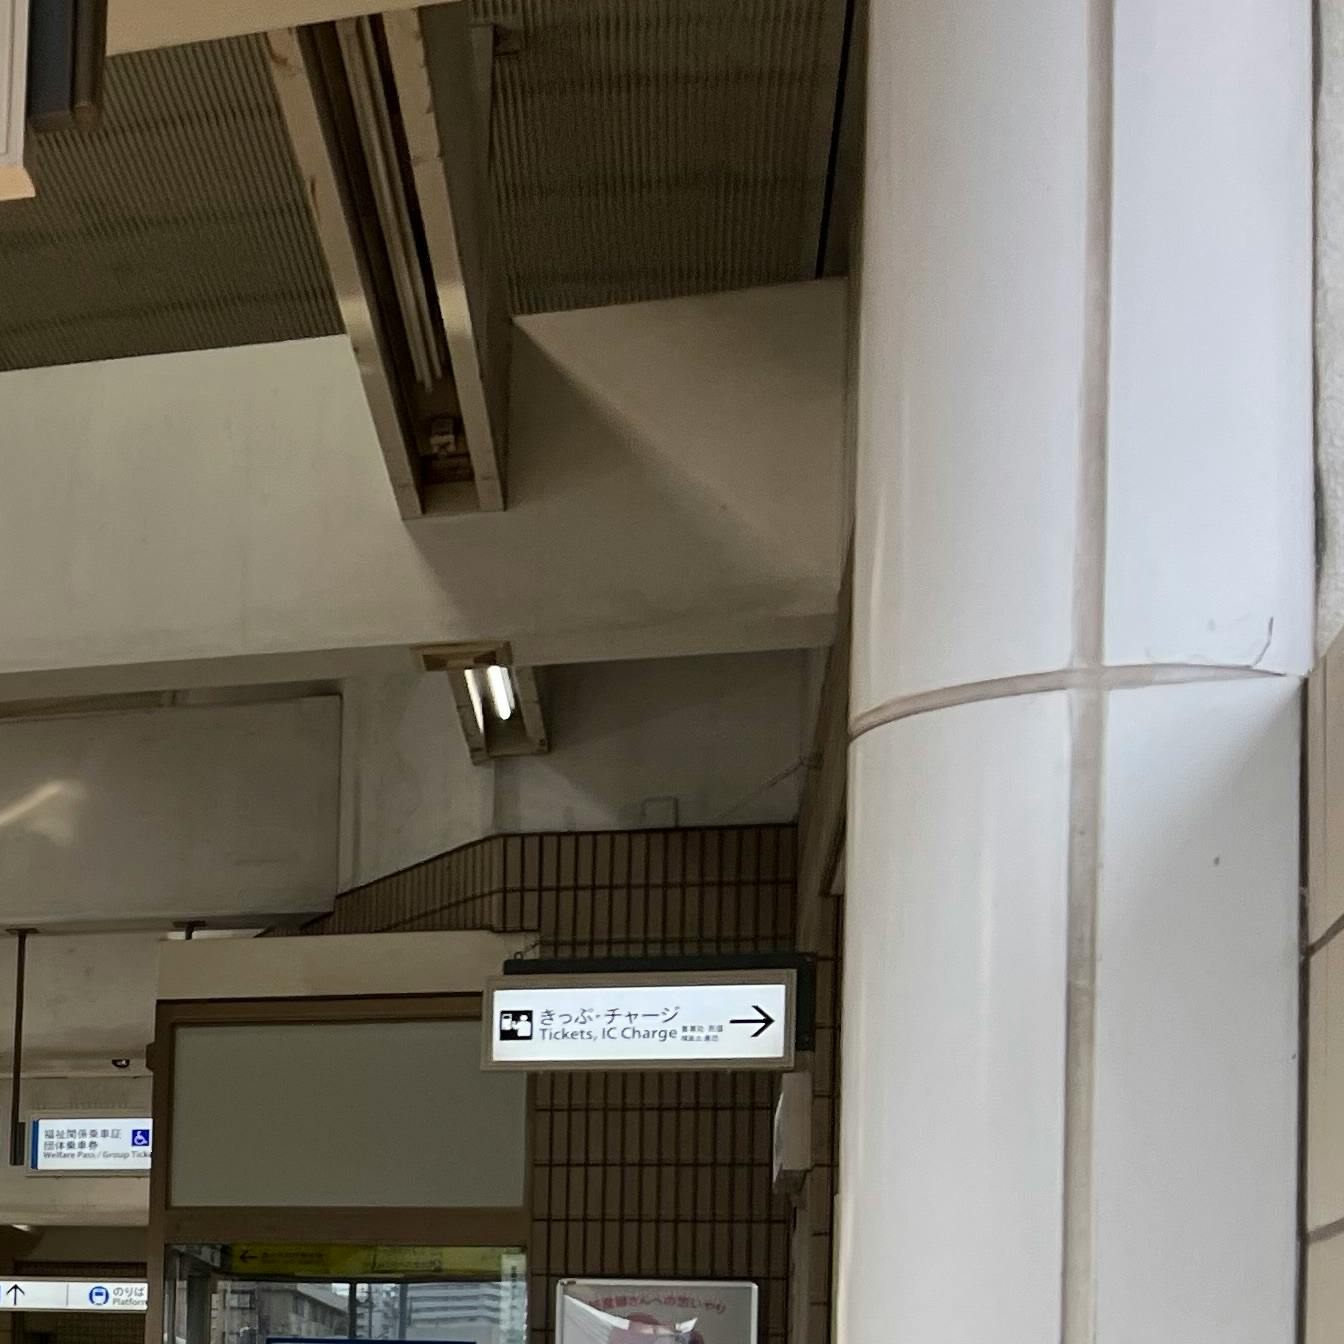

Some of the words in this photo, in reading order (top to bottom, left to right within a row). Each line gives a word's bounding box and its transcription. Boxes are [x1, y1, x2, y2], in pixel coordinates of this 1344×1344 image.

[540, 1006, 681, 1026] きっぷ・チャージ
[540, 1028, 598, 1042] Tickets,
[602, 1027, 618, 1040] IC
[621, 1027, 678, 1042] Charge
[43, 1151, 75, 1159] Welfare
[102, 1151, 130, 1159] Group
[113, 1287, 146, 1298] のりば
